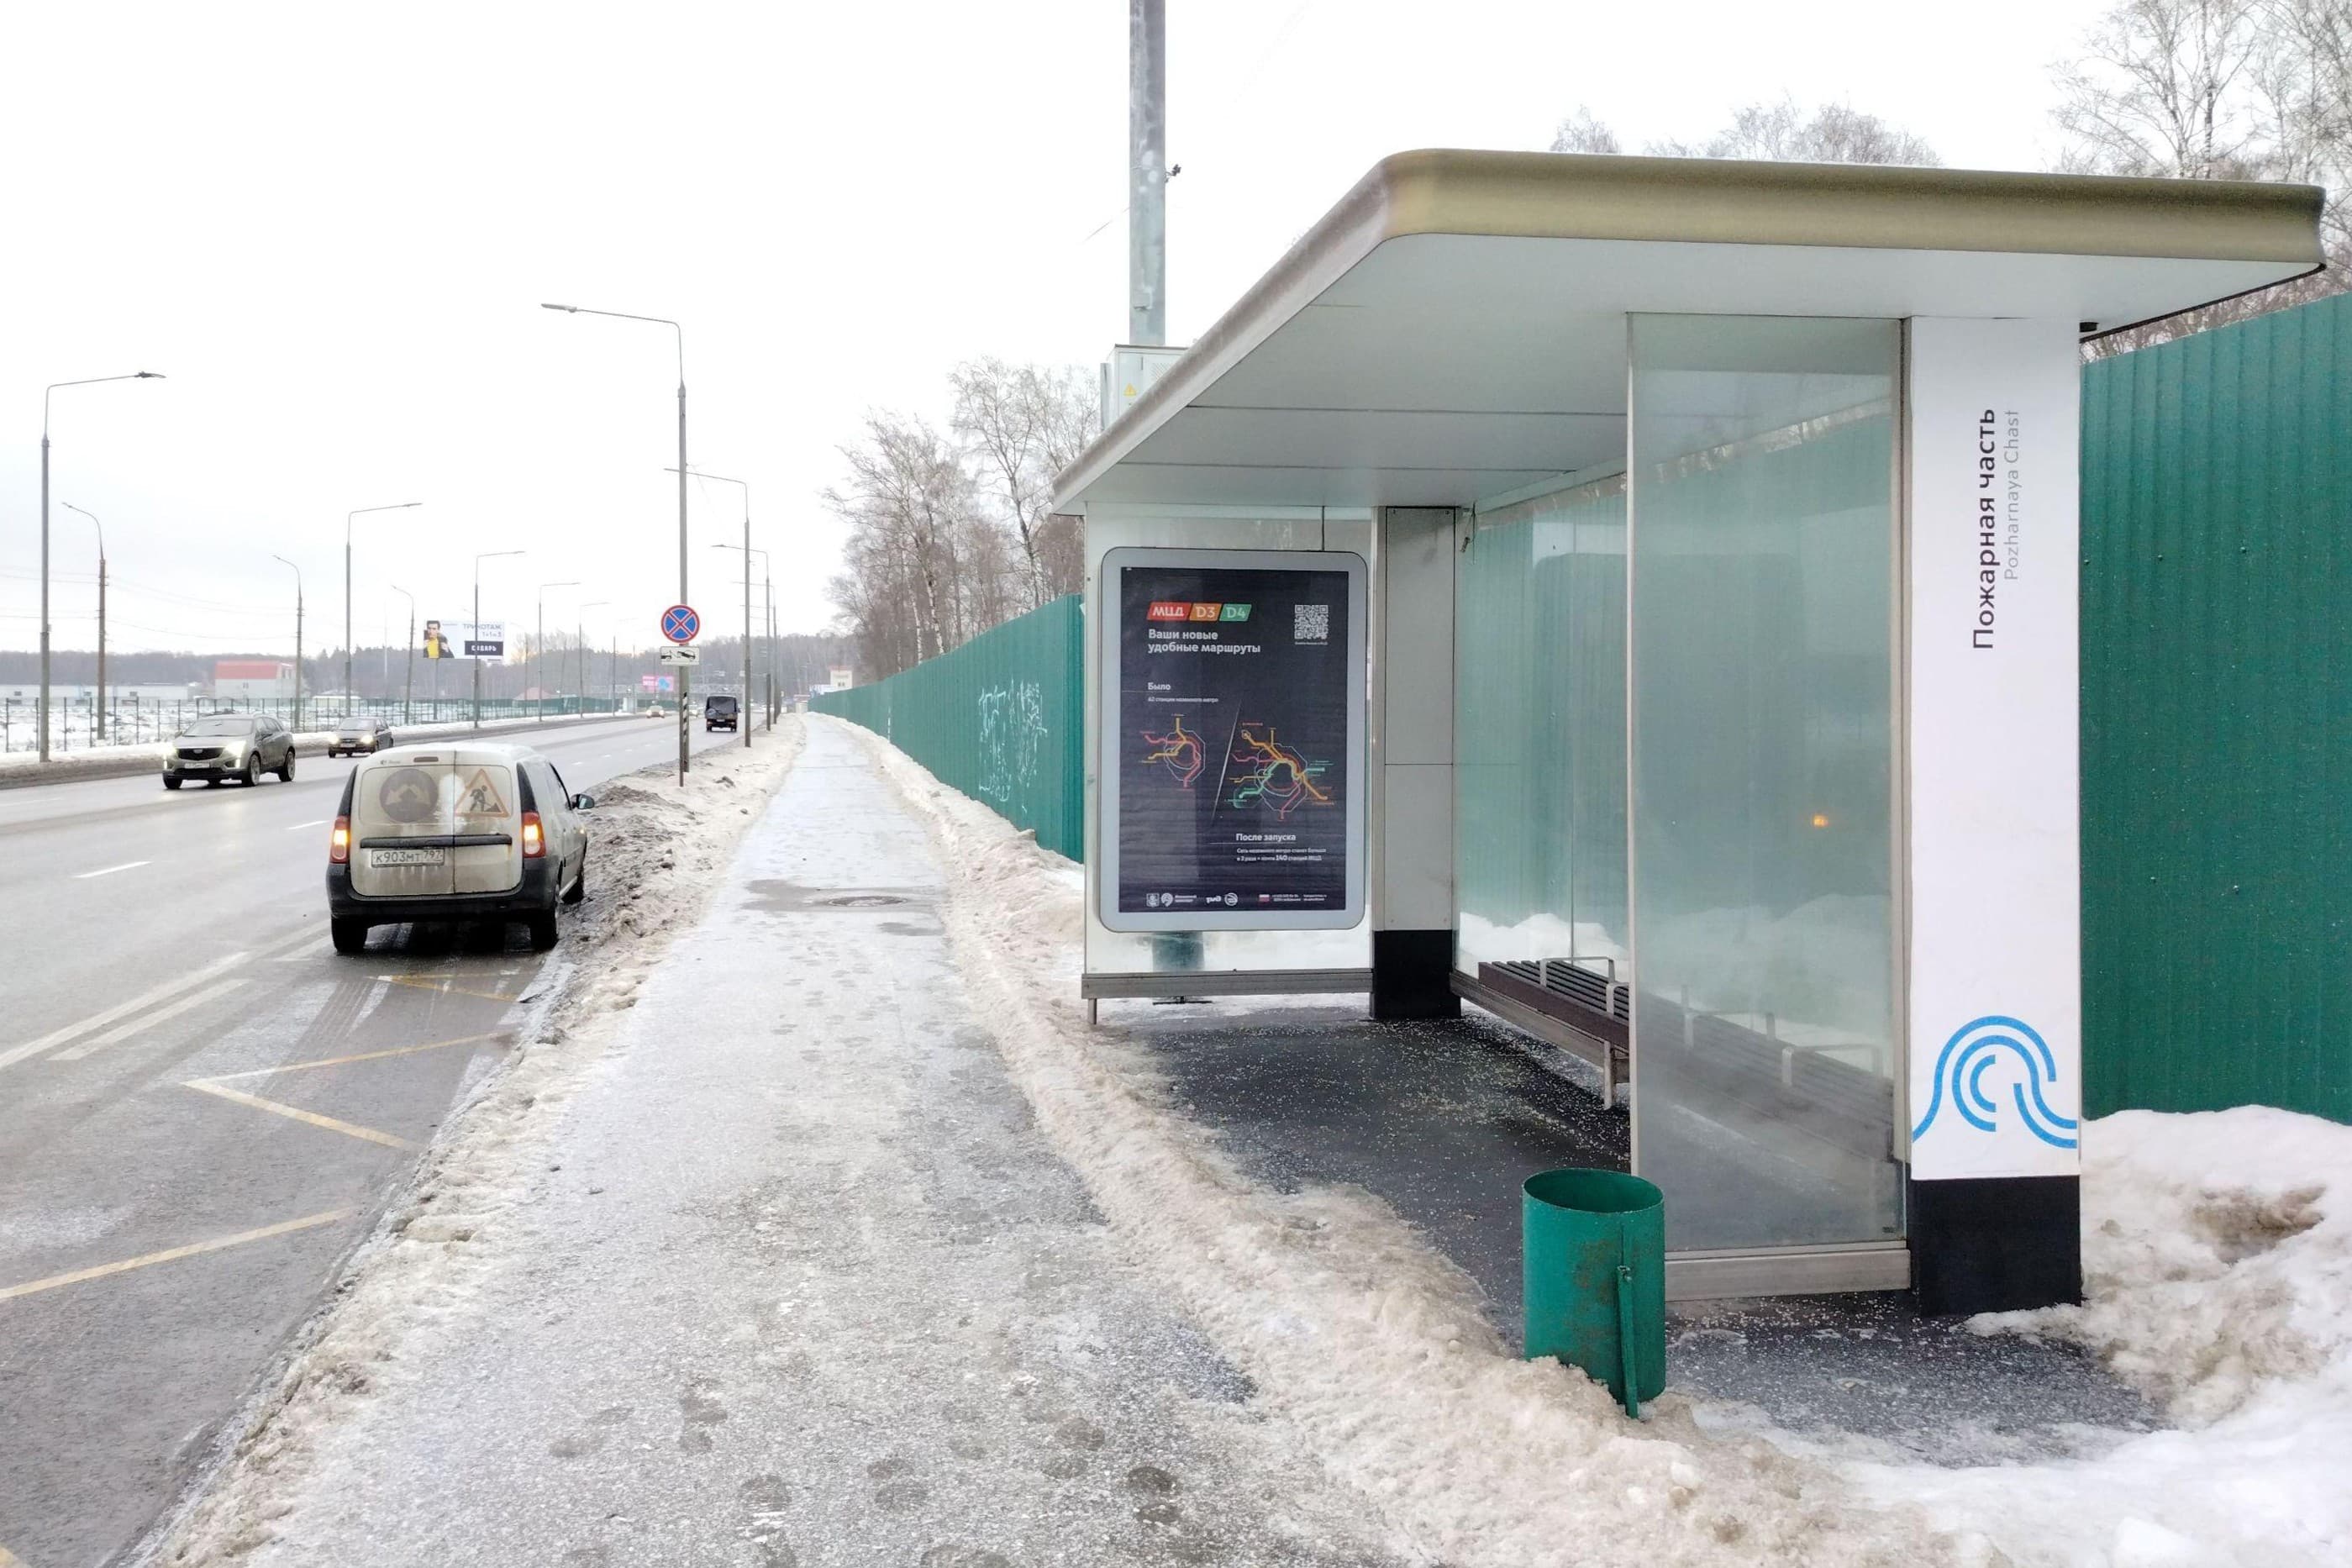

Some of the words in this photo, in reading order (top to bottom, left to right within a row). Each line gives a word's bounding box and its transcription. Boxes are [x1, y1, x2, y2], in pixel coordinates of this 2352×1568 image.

[2003, 409, 2019, 464] Chast
[1979, 409, 1995, 488] часть
[2003, 470, 2023, 581] Pozharnaya
[1972, 497, 2000, 650] Пожарная
[1152, 606, 1185, 618] МЦД
[1195, 606, 1216, 618] D3
[1226, 607, 1246, 619] D4
[1148, 629, 1180, 639] Ваши
[1182, 631, 1218, 640] новые
[1147, 641, 1199, 654] удобные
[1201, 644, 1261, 655] маршруты
[1147, 681, 1171, 691] Было
[1235, 833, 1263, 841] После
[1263, 834, 1297, 843] запуска
